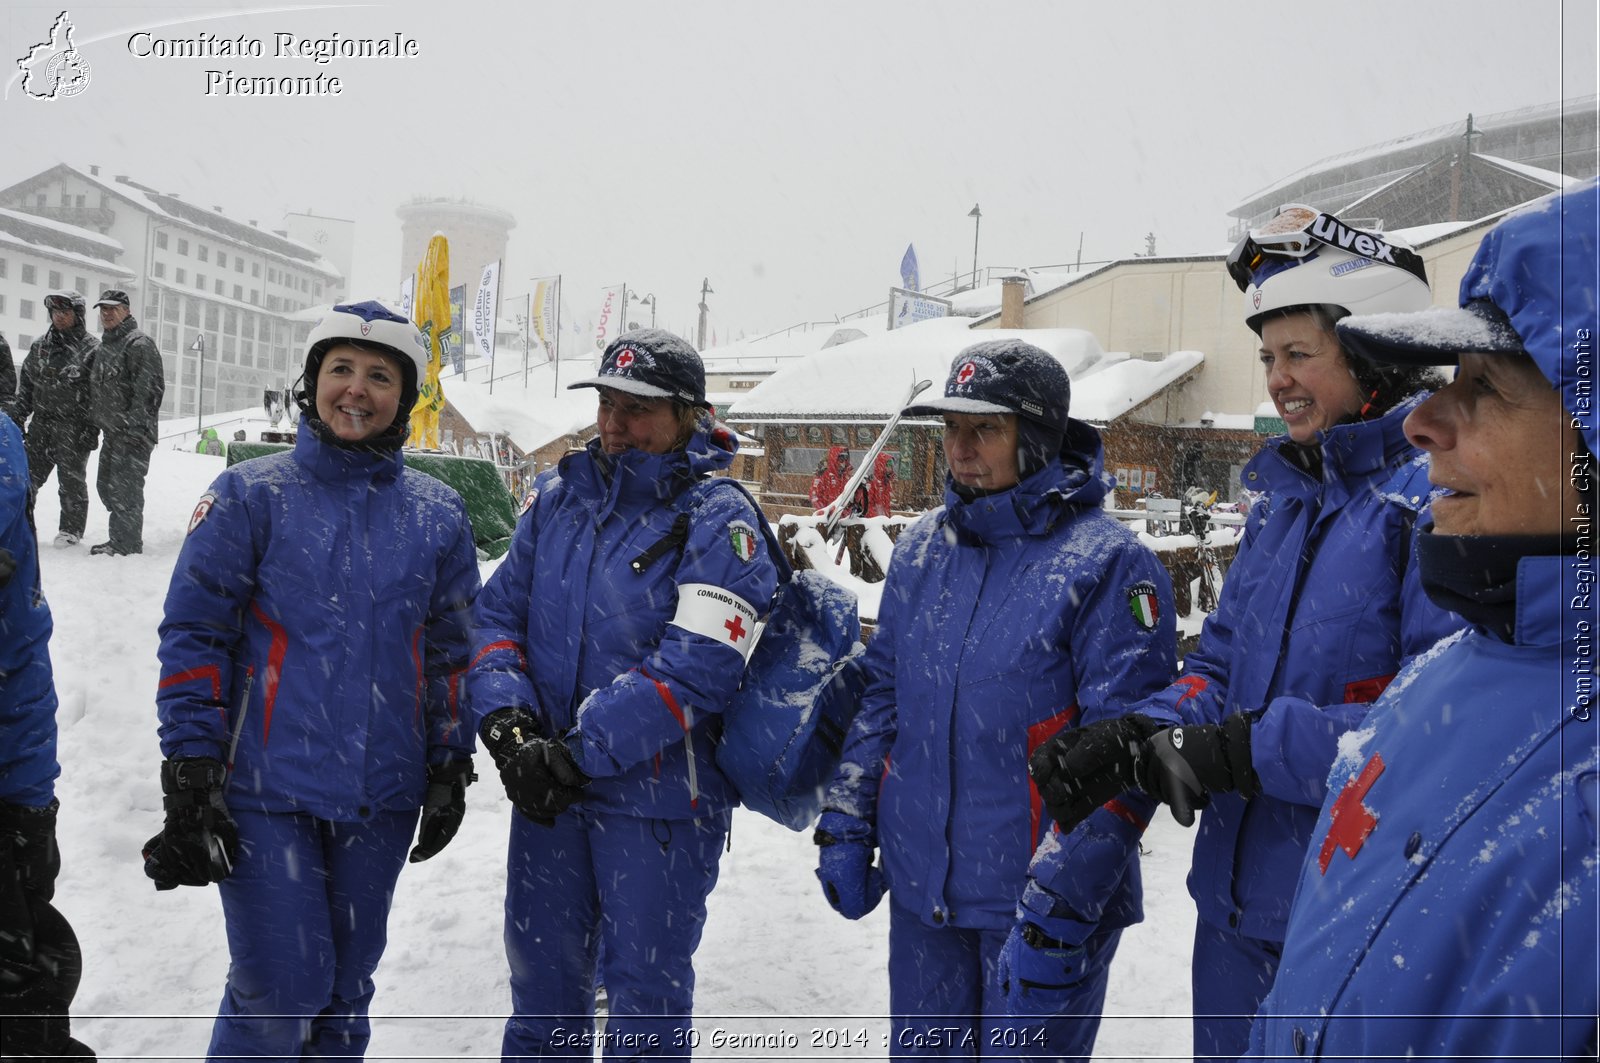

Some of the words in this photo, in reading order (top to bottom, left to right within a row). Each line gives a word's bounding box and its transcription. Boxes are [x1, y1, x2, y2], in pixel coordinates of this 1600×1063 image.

[1312, 215, 1396, 264] uvex
[697, 588, 733, 606] COMANDO
[734, 600, 754, 619] TRUPPE
[1131, 588, 1153, 597] ITALIA
